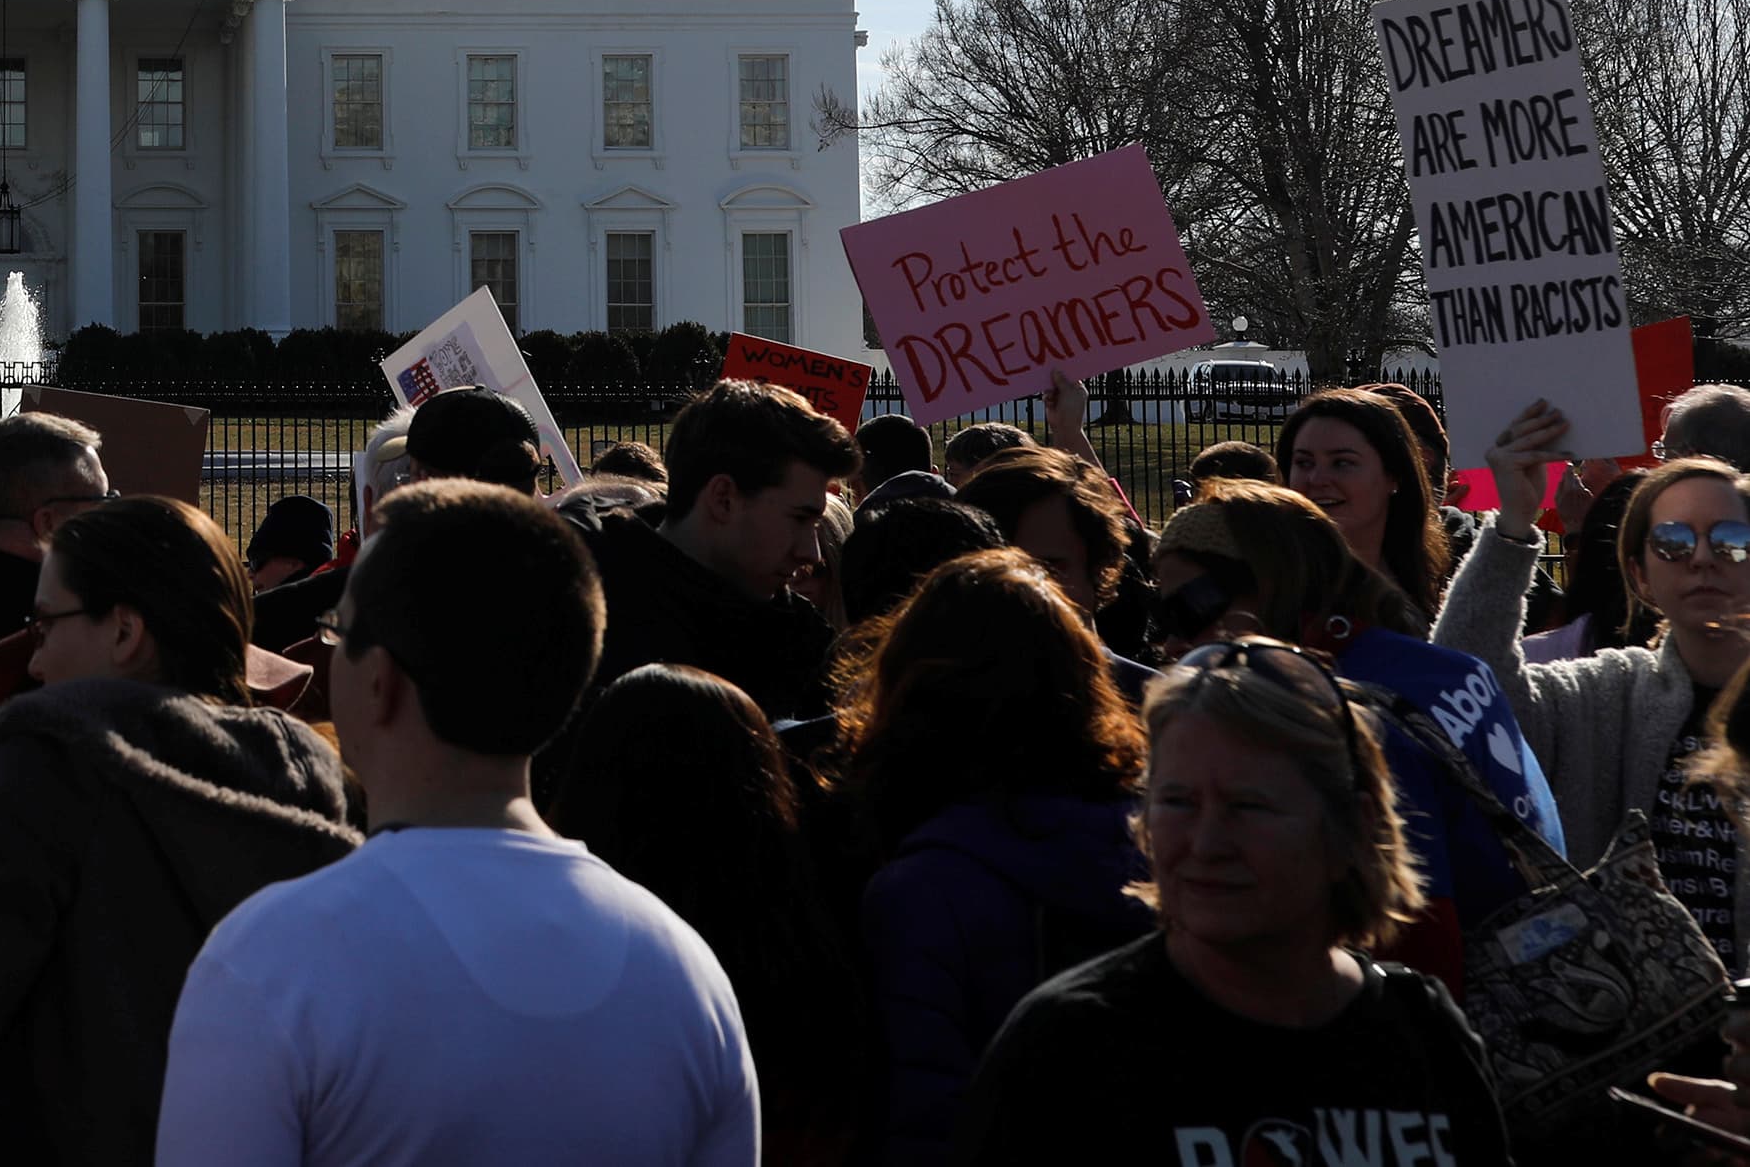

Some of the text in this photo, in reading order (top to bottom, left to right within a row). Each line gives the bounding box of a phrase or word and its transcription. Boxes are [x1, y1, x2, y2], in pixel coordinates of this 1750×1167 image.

[1413, 88, 1589, 177] ARE MORE
[891, 213, 1148, 313] Protect the
[1429, 186, 1614, 268] AMERICAN
[1430, 275, 1622, 348] THAN RACISTS
[742, 344, 865, 388] WOMEN'S
